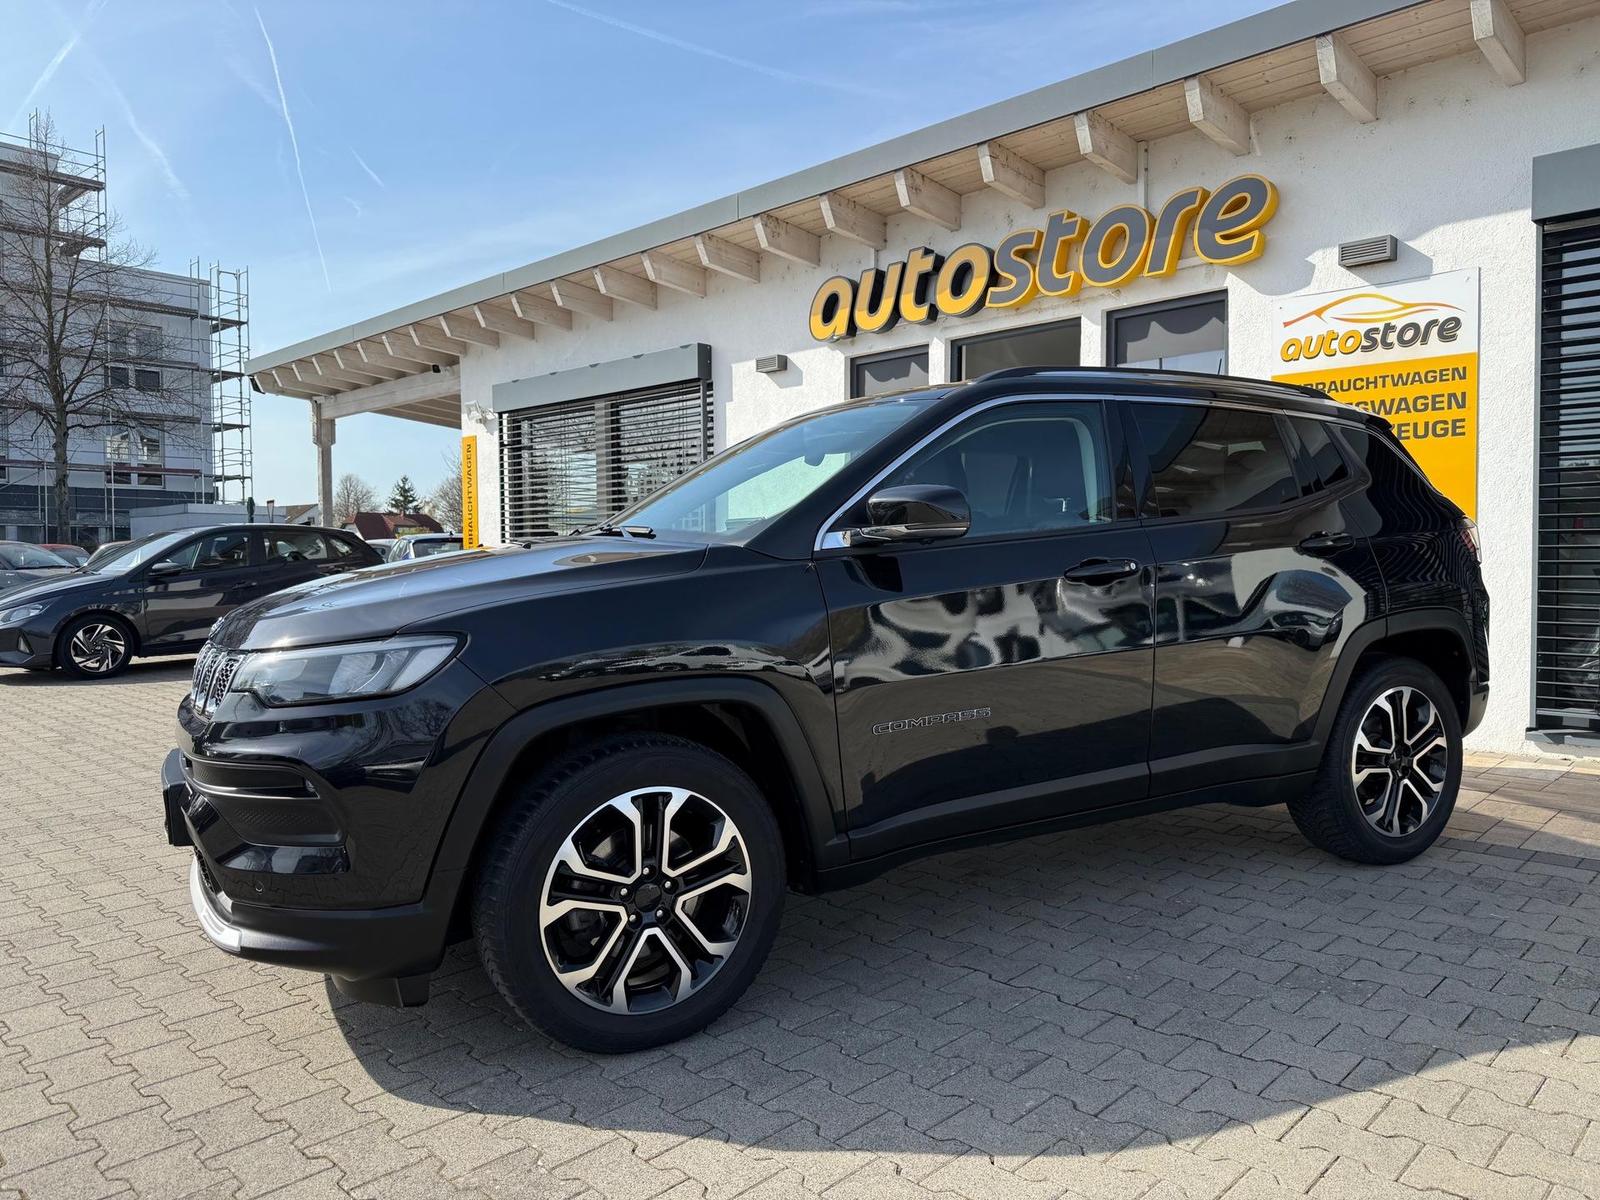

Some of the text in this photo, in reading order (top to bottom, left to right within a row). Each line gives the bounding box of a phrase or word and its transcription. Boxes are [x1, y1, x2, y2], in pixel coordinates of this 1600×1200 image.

[808, 173, 1280, 343] autostore
[1280, 316, 1462, 362] autostore
[1392, 418, 1466, 441] EUGE
[872, 707, 991, 735] COMPASS
